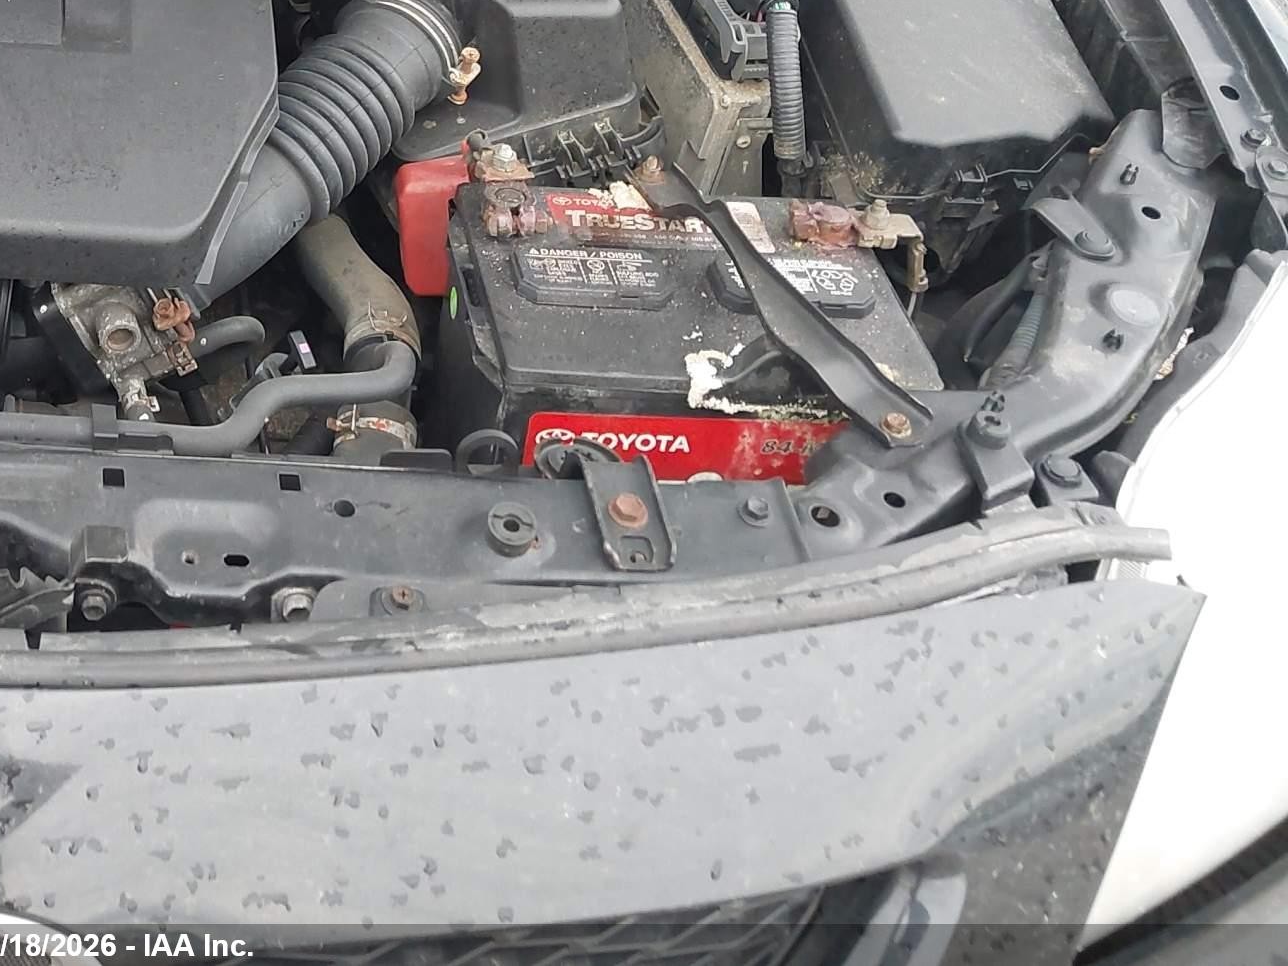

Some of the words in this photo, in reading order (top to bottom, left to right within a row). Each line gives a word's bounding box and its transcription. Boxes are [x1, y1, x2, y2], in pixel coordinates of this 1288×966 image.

[540, 248, 588, 257] DANGER
[599, 251, 643, 260] POISON
[581, 431, 690, 453] TOYOTA
